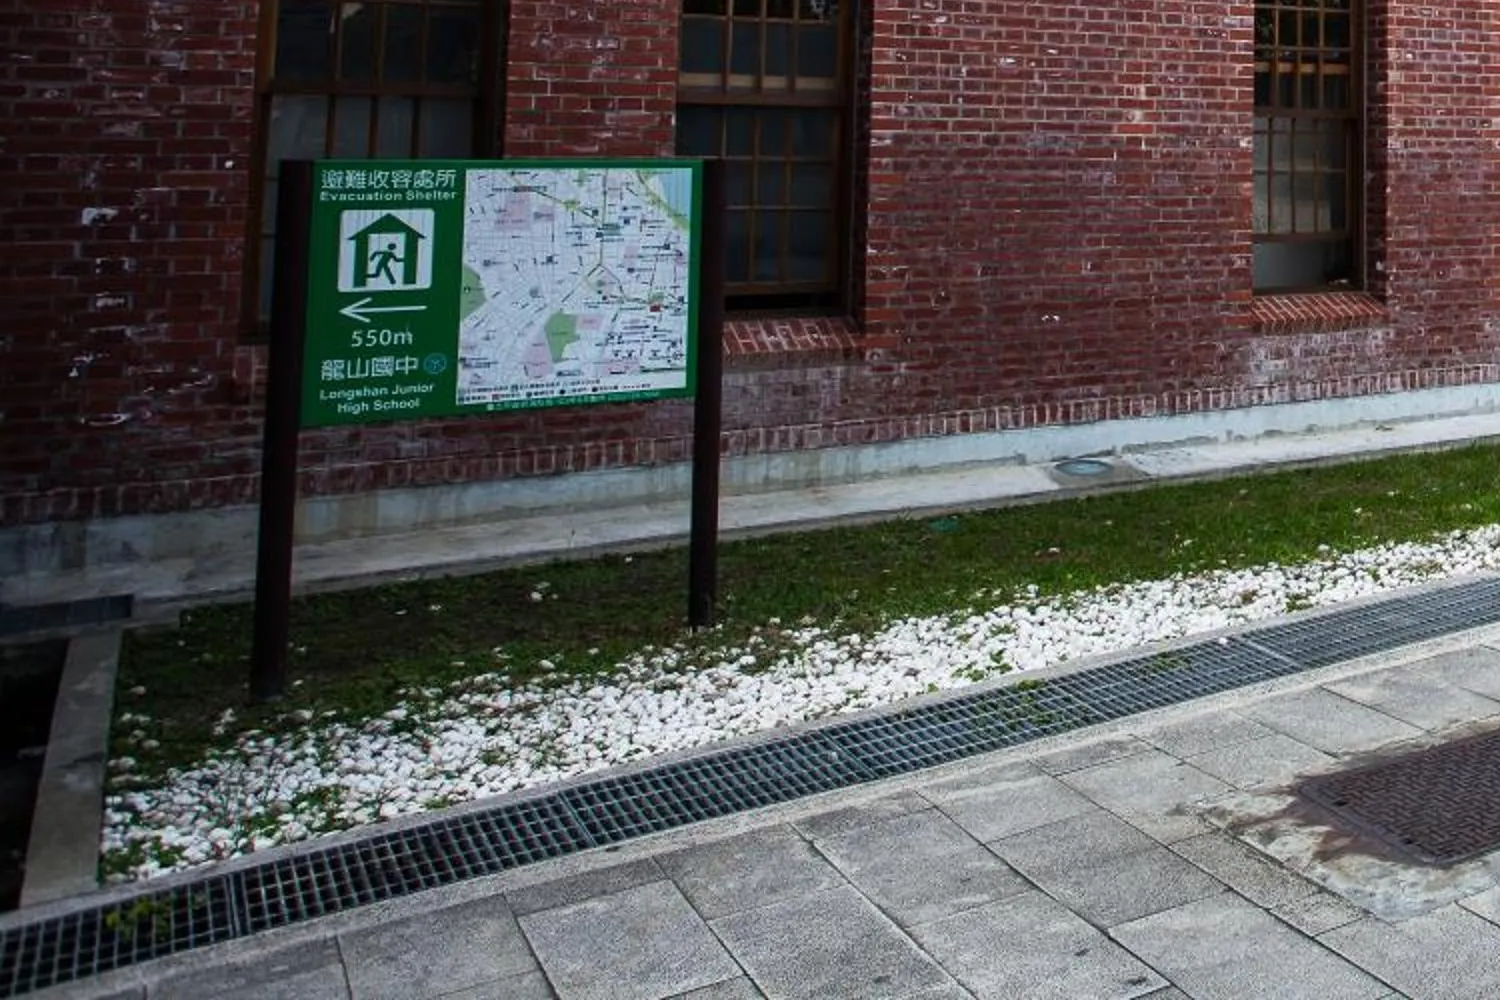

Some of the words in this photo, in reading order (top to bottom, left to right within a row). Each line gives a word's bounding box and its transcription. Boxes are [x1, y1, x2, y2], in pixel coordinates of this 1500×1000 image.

[321, 169, 456, 189] 避難收容處所
[320, 191, 403, 201] Evacuation
[406, 190, 456, 200] Shelter
[351, 329, 413, 347] 550m
[321, 355, 419, 381] 龍山國中
[320, 386, 388, 400] Longshan
[392, 383, 434, 395] Junior
[337, 402, 368, 414] High
[373, 398, 420, 410] School
